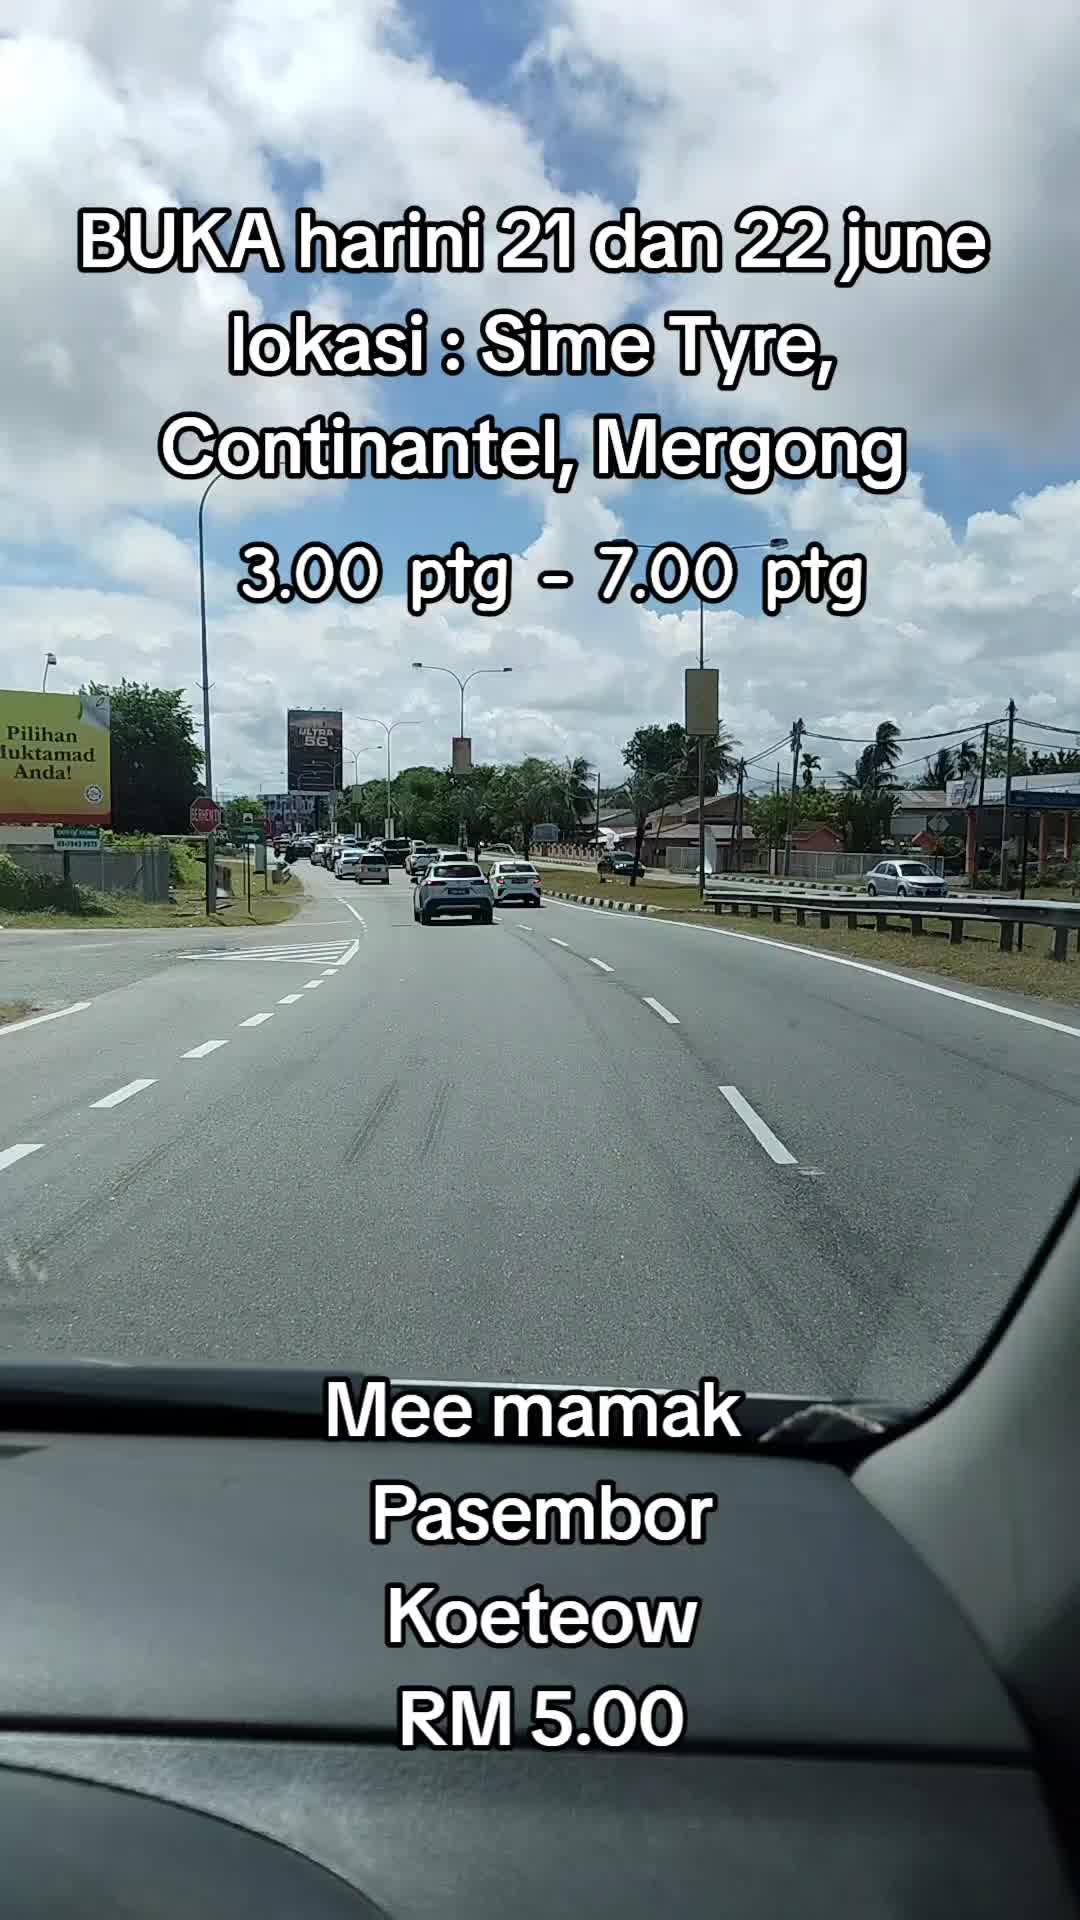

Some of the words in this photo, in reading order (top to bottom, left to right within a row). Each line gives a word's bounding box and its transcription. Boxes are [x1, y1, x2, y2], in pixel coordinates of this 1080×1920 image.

[7, 726, 77, 743] Pilihan
[298, 728, 334, 736] ULTRA
[304, 736, 329, 747] 5G
[14, 763, 72, 780] Anda!
